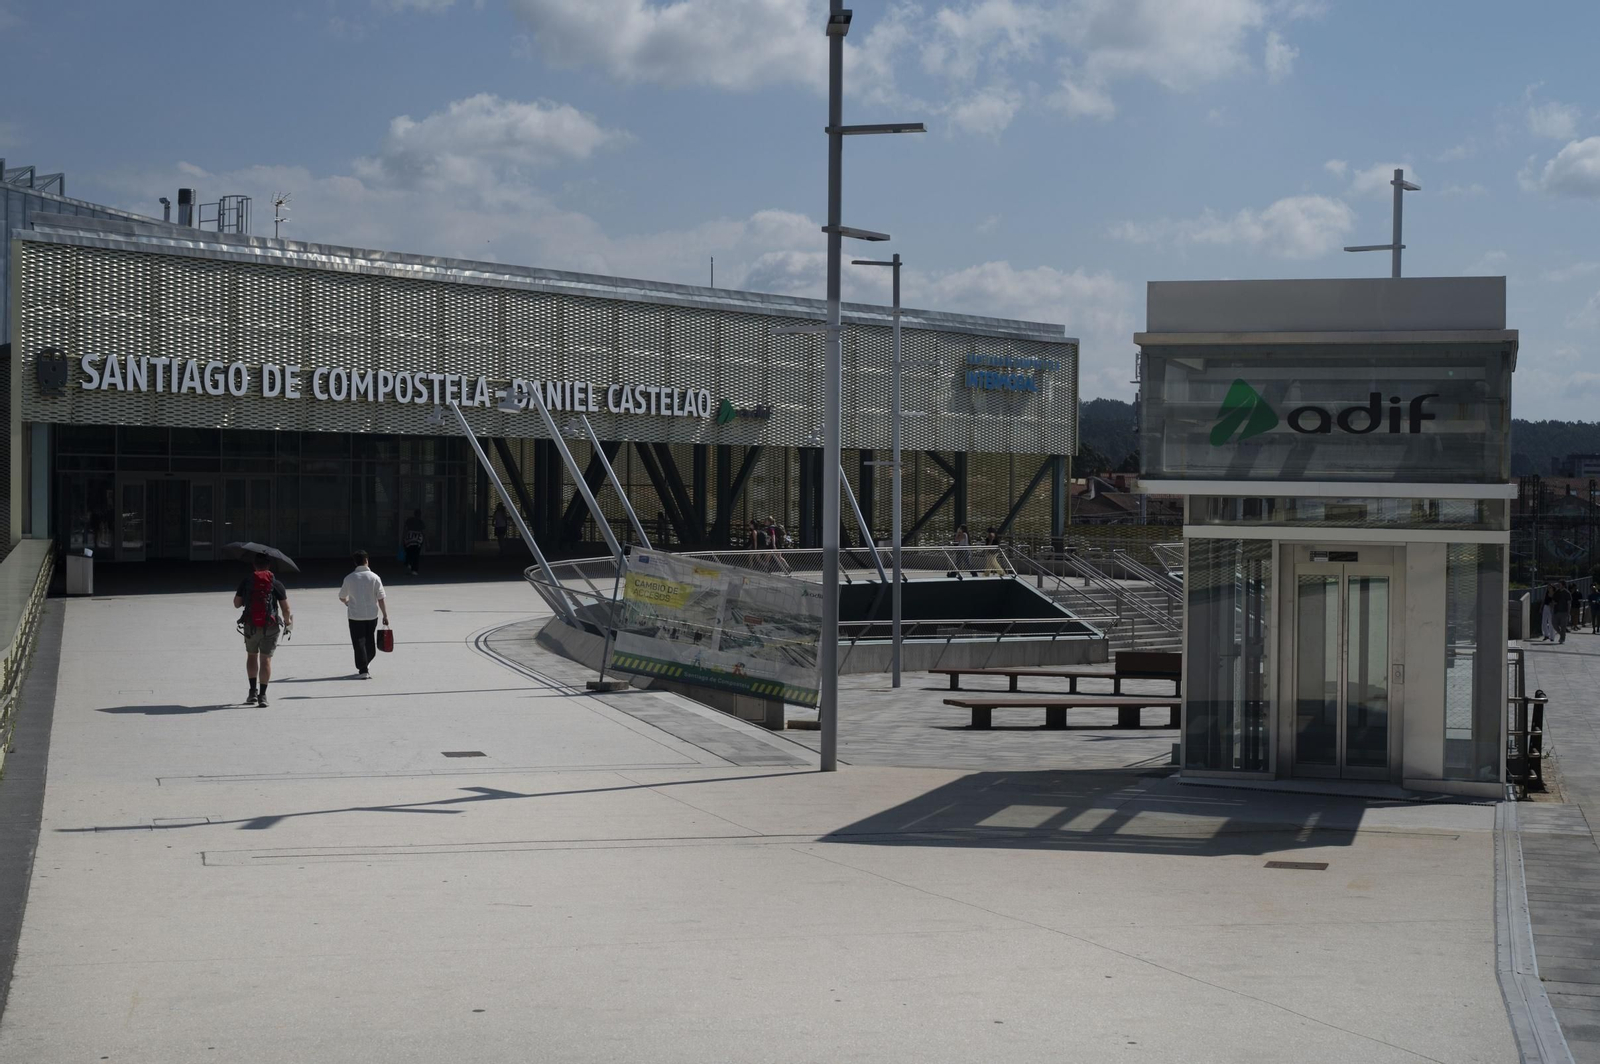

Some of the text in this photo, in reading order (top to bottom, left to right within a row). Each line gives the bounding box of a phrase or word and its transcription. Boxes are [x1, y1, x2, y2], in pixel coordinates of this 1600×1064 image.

[81, 353, 248, 397] SANTIAGO
[262, 363, 300, 399] DE
[313, 367, 491, 407] COMPOSTELA
[512, 378, 599, 412] DANIEL
[607, 383, 711, 418] CASTELAO
[1286, 391, 1440, 435] adif
[633, 588, 671, 602] ACCESOS
[634, 579, 679, 595] CAMBIO DE
[683, 672, 709, 682] Santiago
